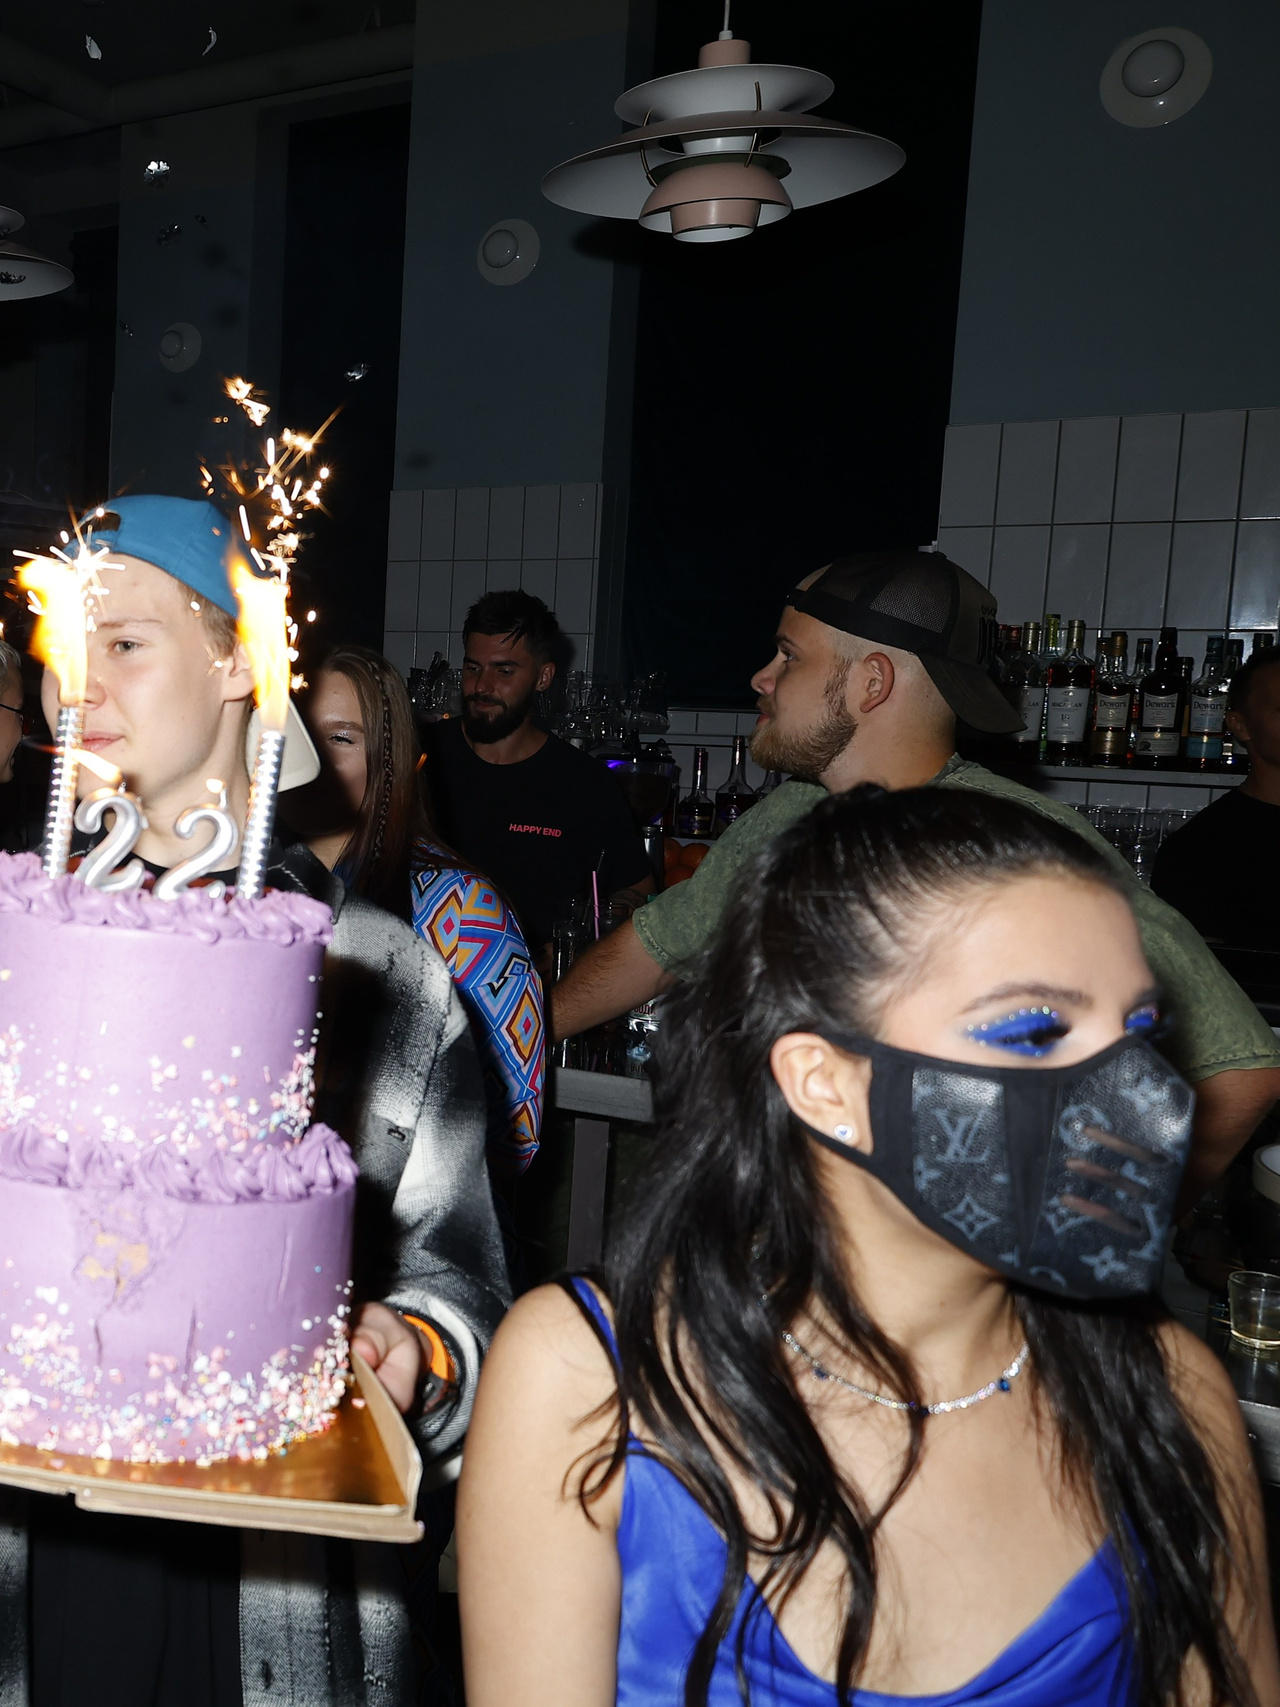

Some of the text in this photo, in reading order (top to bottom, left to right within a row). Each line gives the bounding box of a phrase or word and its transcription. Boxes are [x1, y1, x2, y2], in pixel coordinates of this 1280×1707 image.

[74, 787, 239, 901] 22
[508, 823, 562, 838] HAPPY END
